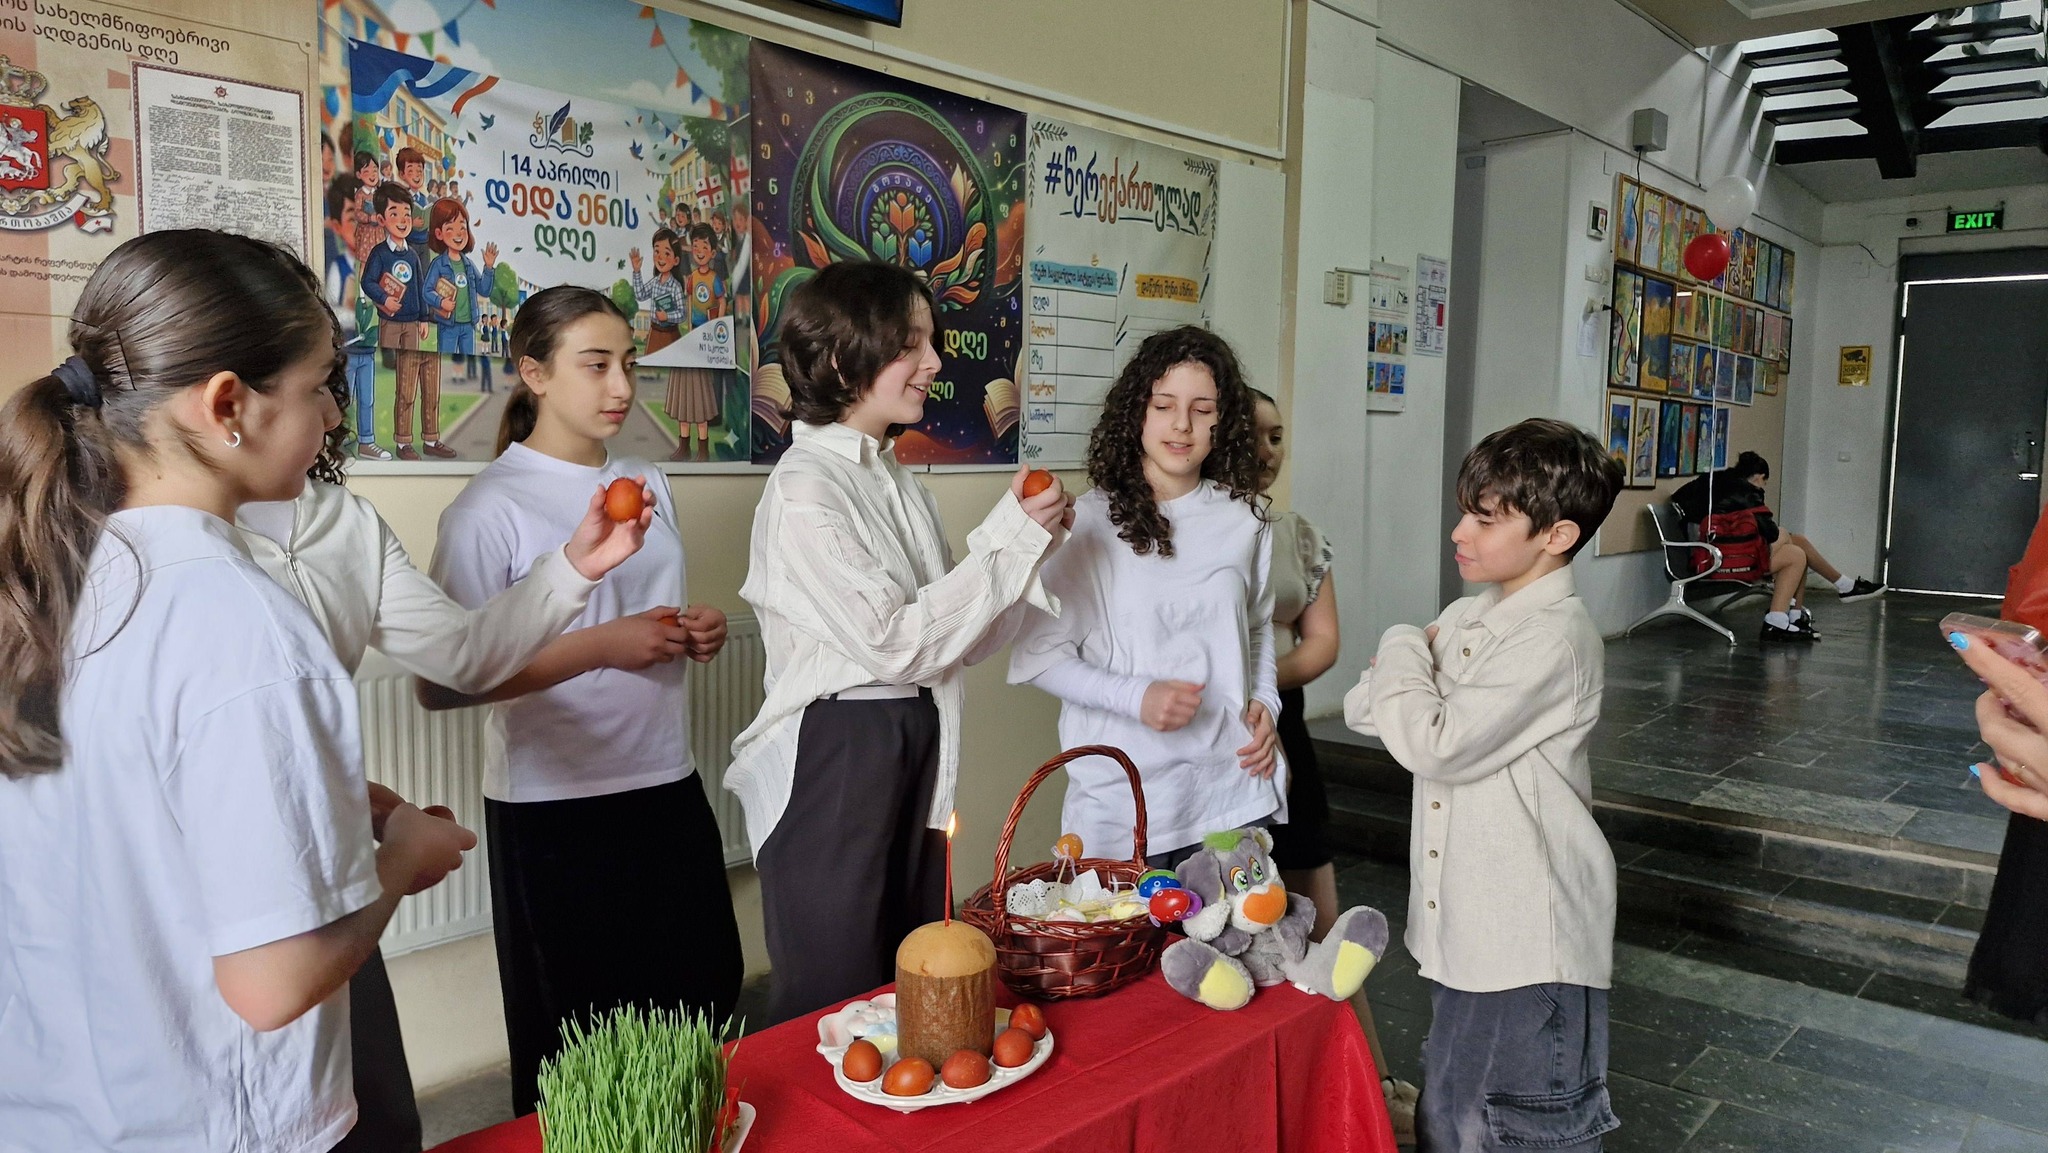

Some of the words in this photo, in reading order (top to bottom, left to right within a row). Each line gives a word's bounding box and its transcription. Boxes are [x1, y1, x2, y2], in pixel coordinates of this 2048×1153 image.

[33, 25, 132, 53] აღდგენის
[138, 44, 178, 65] დღე
[34, 0, 230, 53] სახელმწიფოებრივი
[511, 154, 532, 176] 14
[537, 160, 610, 190] აპრილი
[1044, 145, 1201, 237] #წერექართულად
[485, 178, 572, 221] დედა
[577, 193, 639, 230] ენის
[1954, 212, 1996, 230] EXIT
[534, 223, 596, 262] დღე
[944, 329, 988, 360] დღე
[928, 381, 954, 402] ლი
